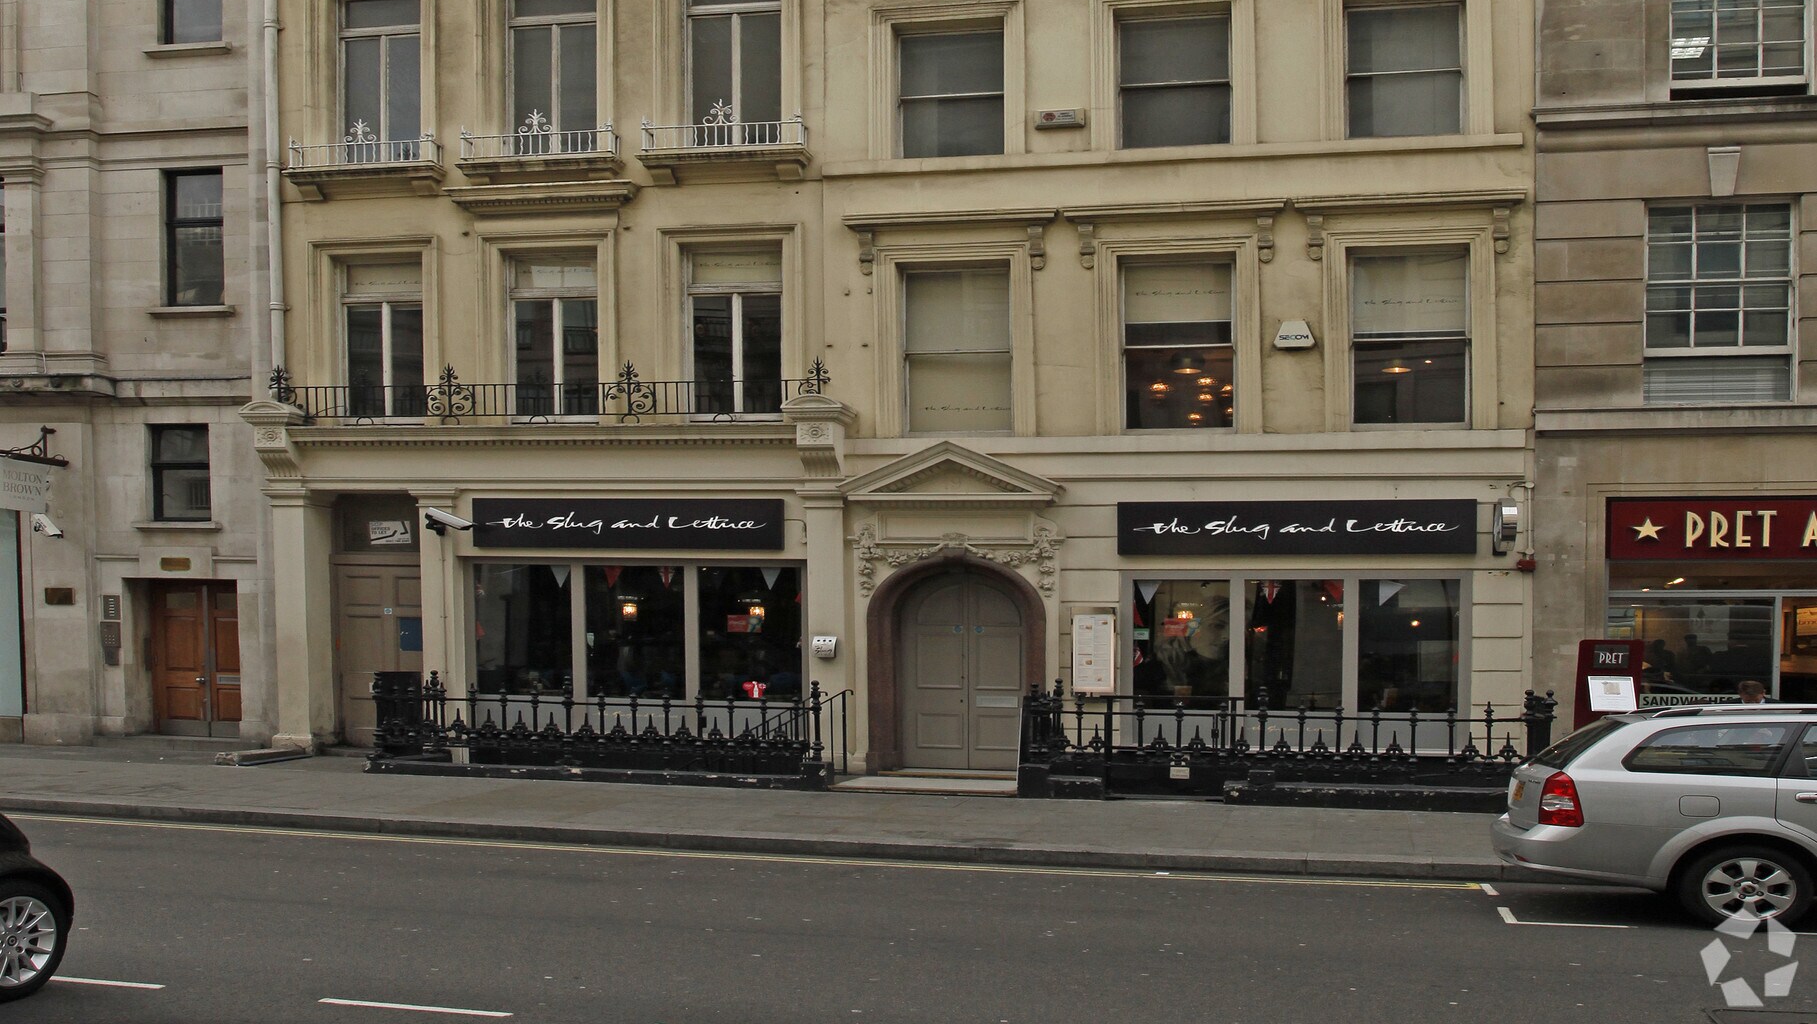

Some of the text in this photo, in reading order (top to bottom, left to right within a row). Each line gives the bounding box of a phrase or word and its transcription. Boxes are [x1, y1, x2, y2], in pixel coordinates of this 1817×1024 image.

[3, 469, 43, 484] MOLTON
[3, 481, 42, 496] BROWN
[486, 511, 768, 534] the Slug and Lettuce
[1133, 515, 1461, 539] the Slug and Lettuce
[1685, 509, 1778, 548] PRET
[1598, 651, 1624, 664] PRET
